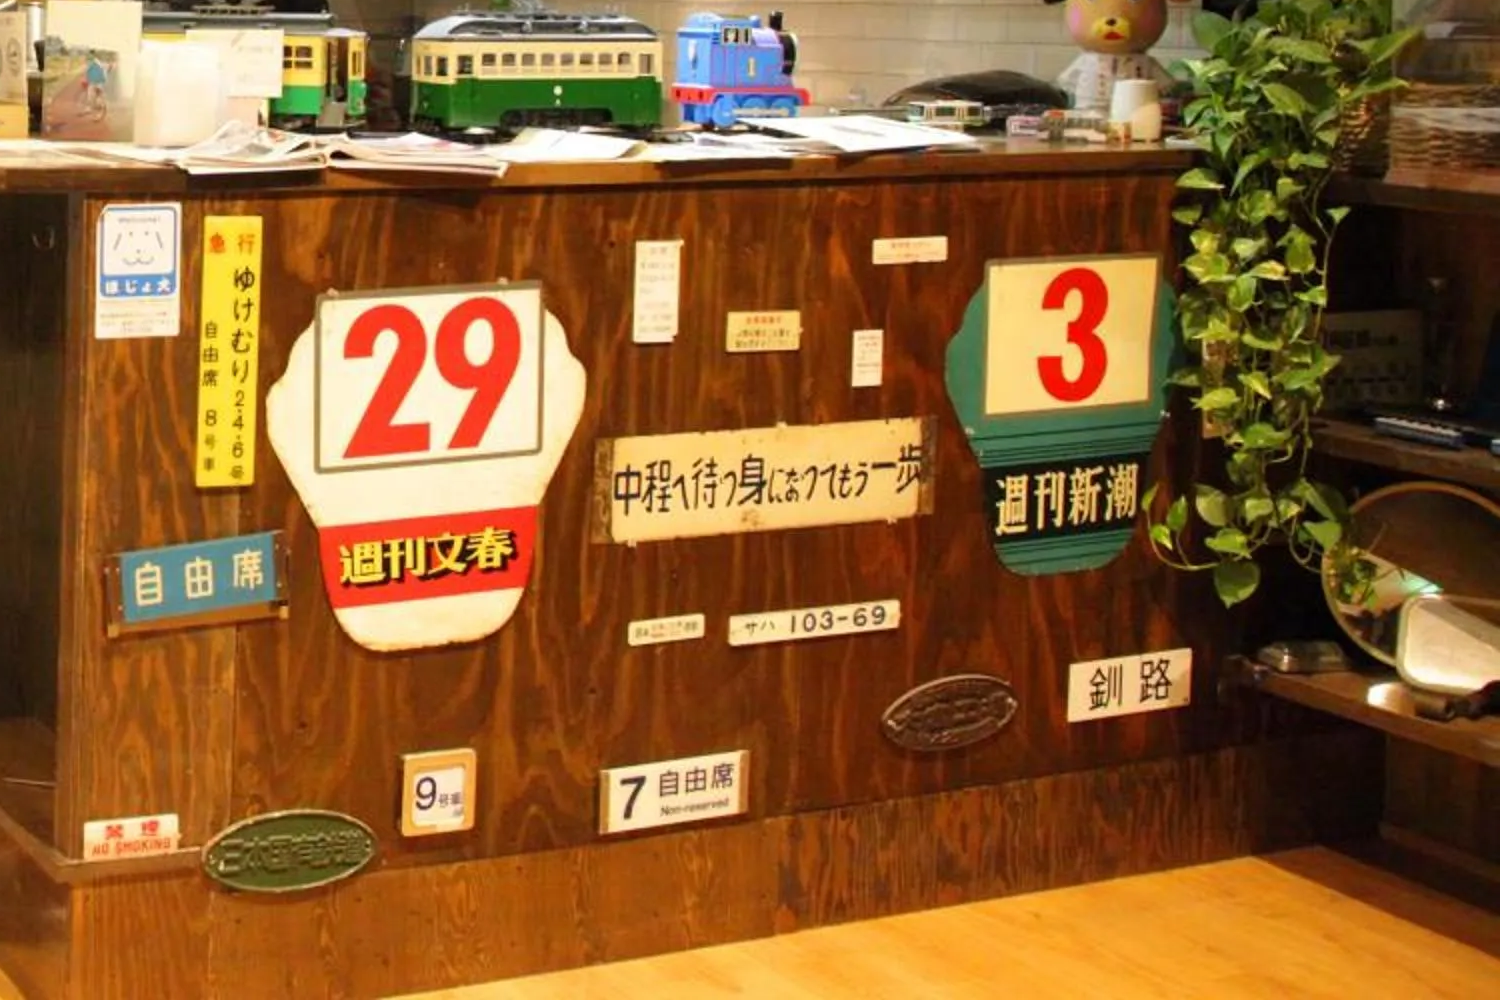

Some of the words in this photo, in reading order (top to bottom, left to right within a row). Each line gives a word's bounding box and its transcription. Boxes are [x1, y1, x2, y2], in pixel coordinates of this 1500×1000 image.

[210, 233, 255, 255] 急行
[202, 321, 219, 387] 自由席
[1037, 267, 1108, 403] 3
[343, 296, 522, 460] 29
[204, 410, 217, 472] 8号車
[995, 463, 1139, 537] 週刊新潮
[135, 549, 265, 608] 自由席
[339, 527, 516, 588] 週刊文春
[790, 605, 887, 633] 103-69
[1088, 658, 1172, 712] 釧路
[620, 775, 646, 820] 7
[659, 763, 735, 797] 自由席
[659, 798, 730, 817] Non-reserved
